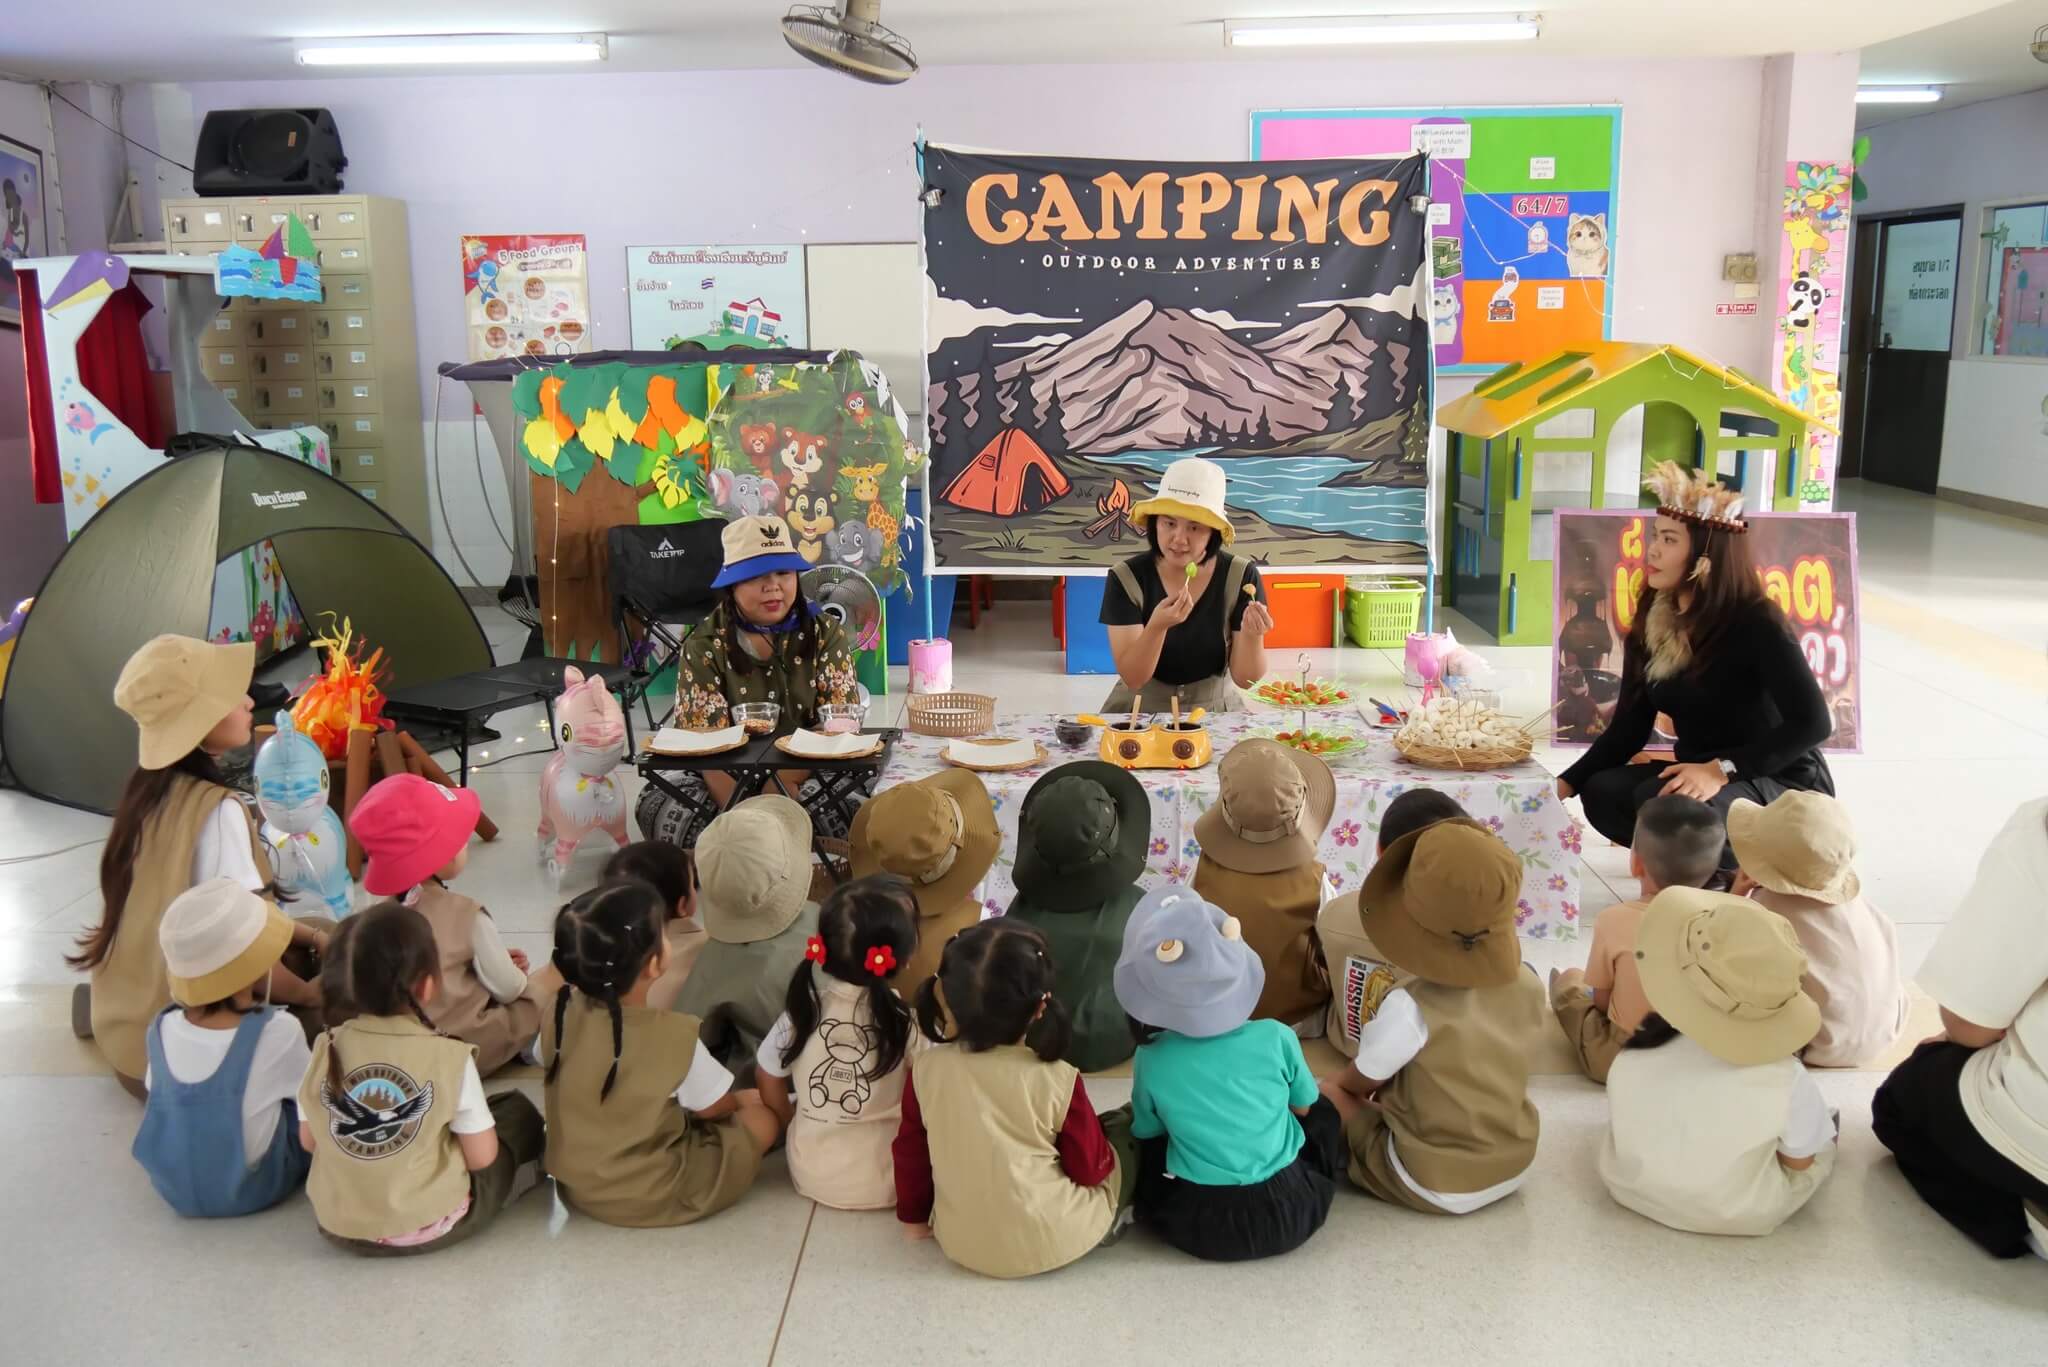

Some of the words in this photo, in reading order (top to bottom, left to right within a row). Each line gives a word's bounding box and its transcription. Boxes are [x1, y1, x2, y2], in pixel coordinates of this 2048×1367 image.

[966, 172, 1399, 246] CAMPING
[1516, 196, 1566, 215] 64/7
[499, 251, 507, 261] 5
[510, 250, 537, 260] Food
[541, 244, 581, 256] Groups
[1042, 254, 1157, 270] OUTDOOR
[1176, 257, 1322, 271] ADVENTURE
[1912, 260, 1935, 279] อนุบาล
[1938, 259, 1951, 272] 1/7
[761, 540, 785, 548] adidas
[1347, 968, 1366, 1042] JURASSIC
[346, 1133, 409, 1154] CAMPING
